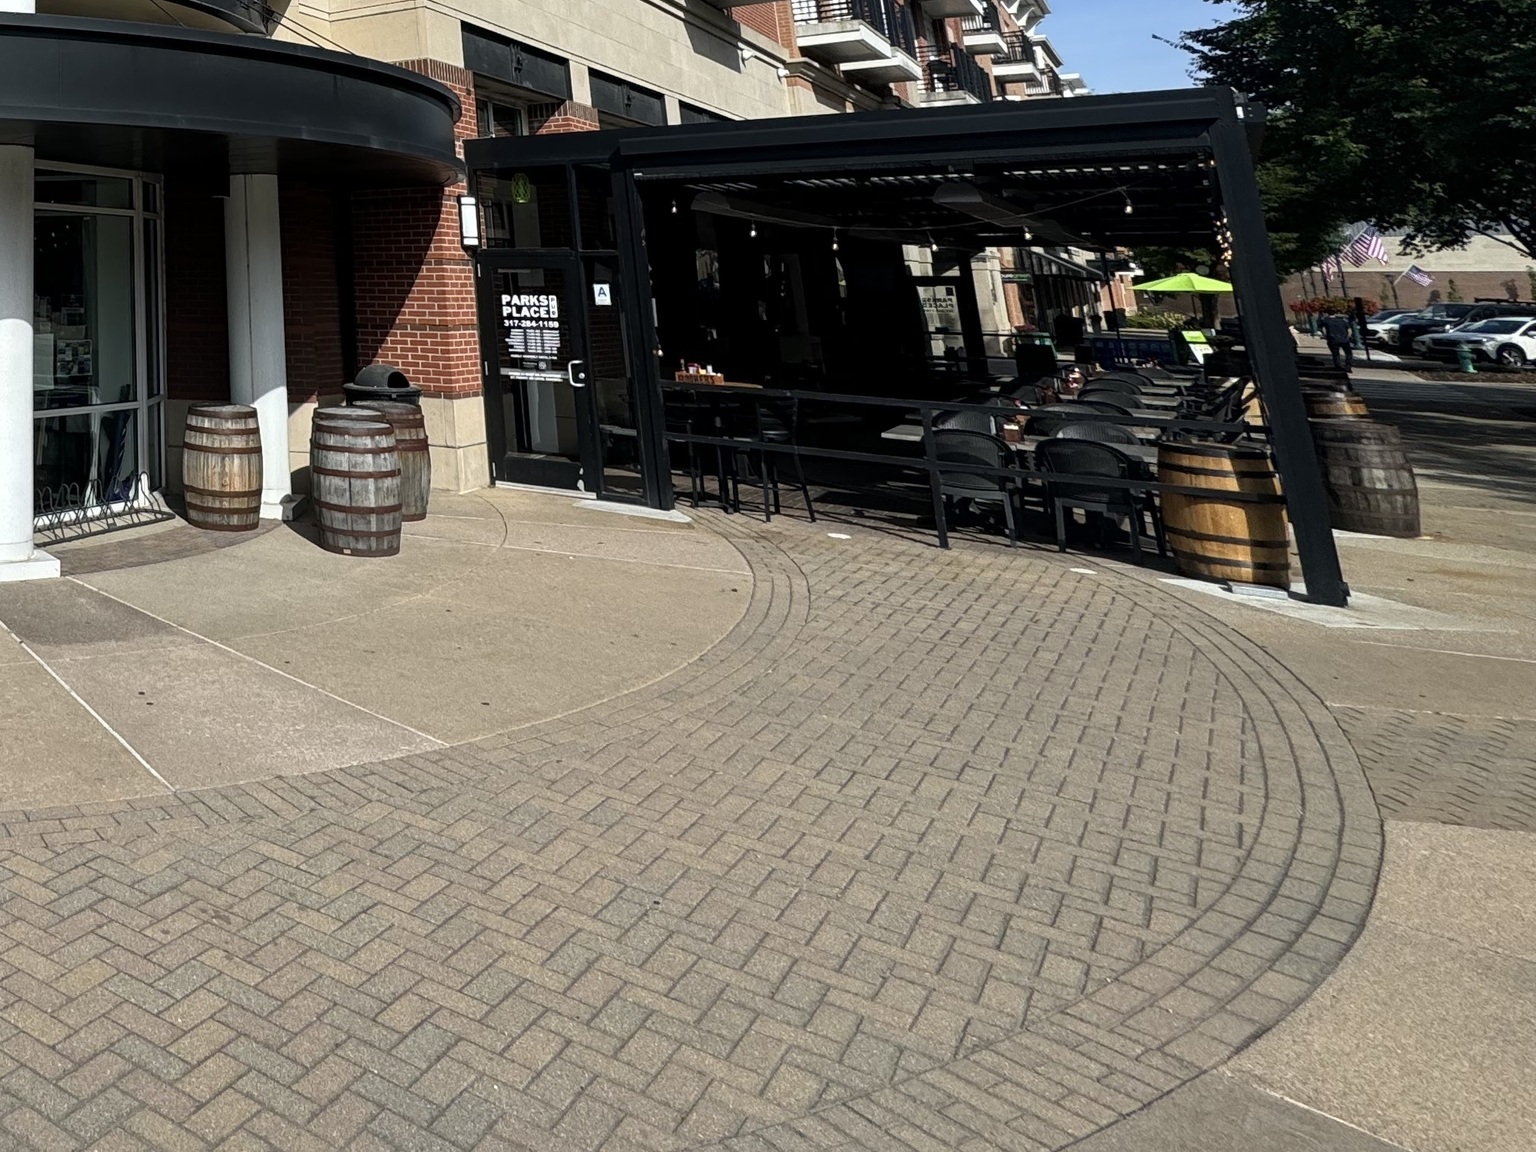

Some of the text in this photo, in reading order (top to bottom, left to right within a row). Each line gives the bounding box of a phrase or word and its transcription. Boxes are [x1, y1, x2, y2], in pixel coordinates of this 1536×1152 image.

[597, 286, 608, 297] A
[501, 294, 549, 306] PARKS
[502, 306, 550, 318] PLACE
